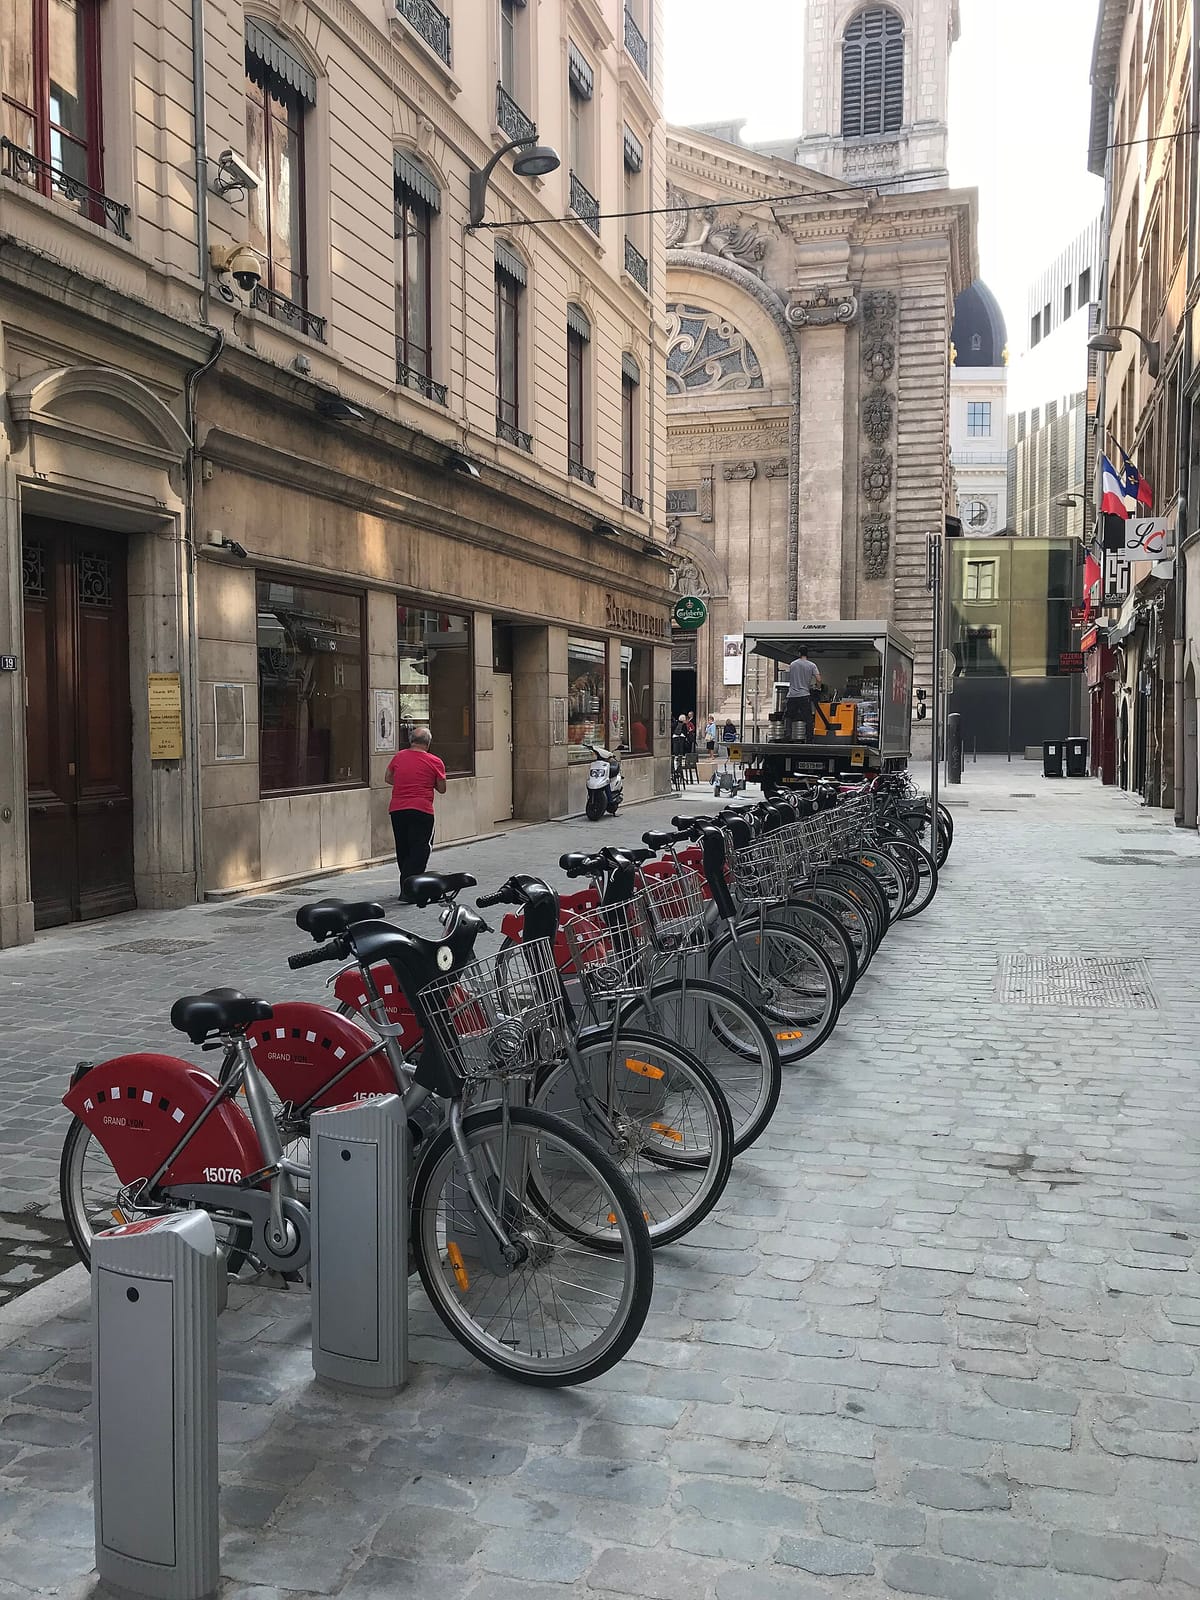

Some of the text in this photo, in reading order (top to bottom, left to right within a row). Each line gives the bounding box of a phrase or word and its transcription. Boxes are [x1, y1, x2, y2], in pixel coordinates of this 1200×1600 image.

[1127, 522, 1166, 553] LC
[676, 608, 704, 619] Carlsberg
[5, 658, 14, 668] 19
[267, 1052, 290, 1061] GRAND
[103, 1115, 126, 1126] GRAND
[203, 1167, 242, 1183] 15076
